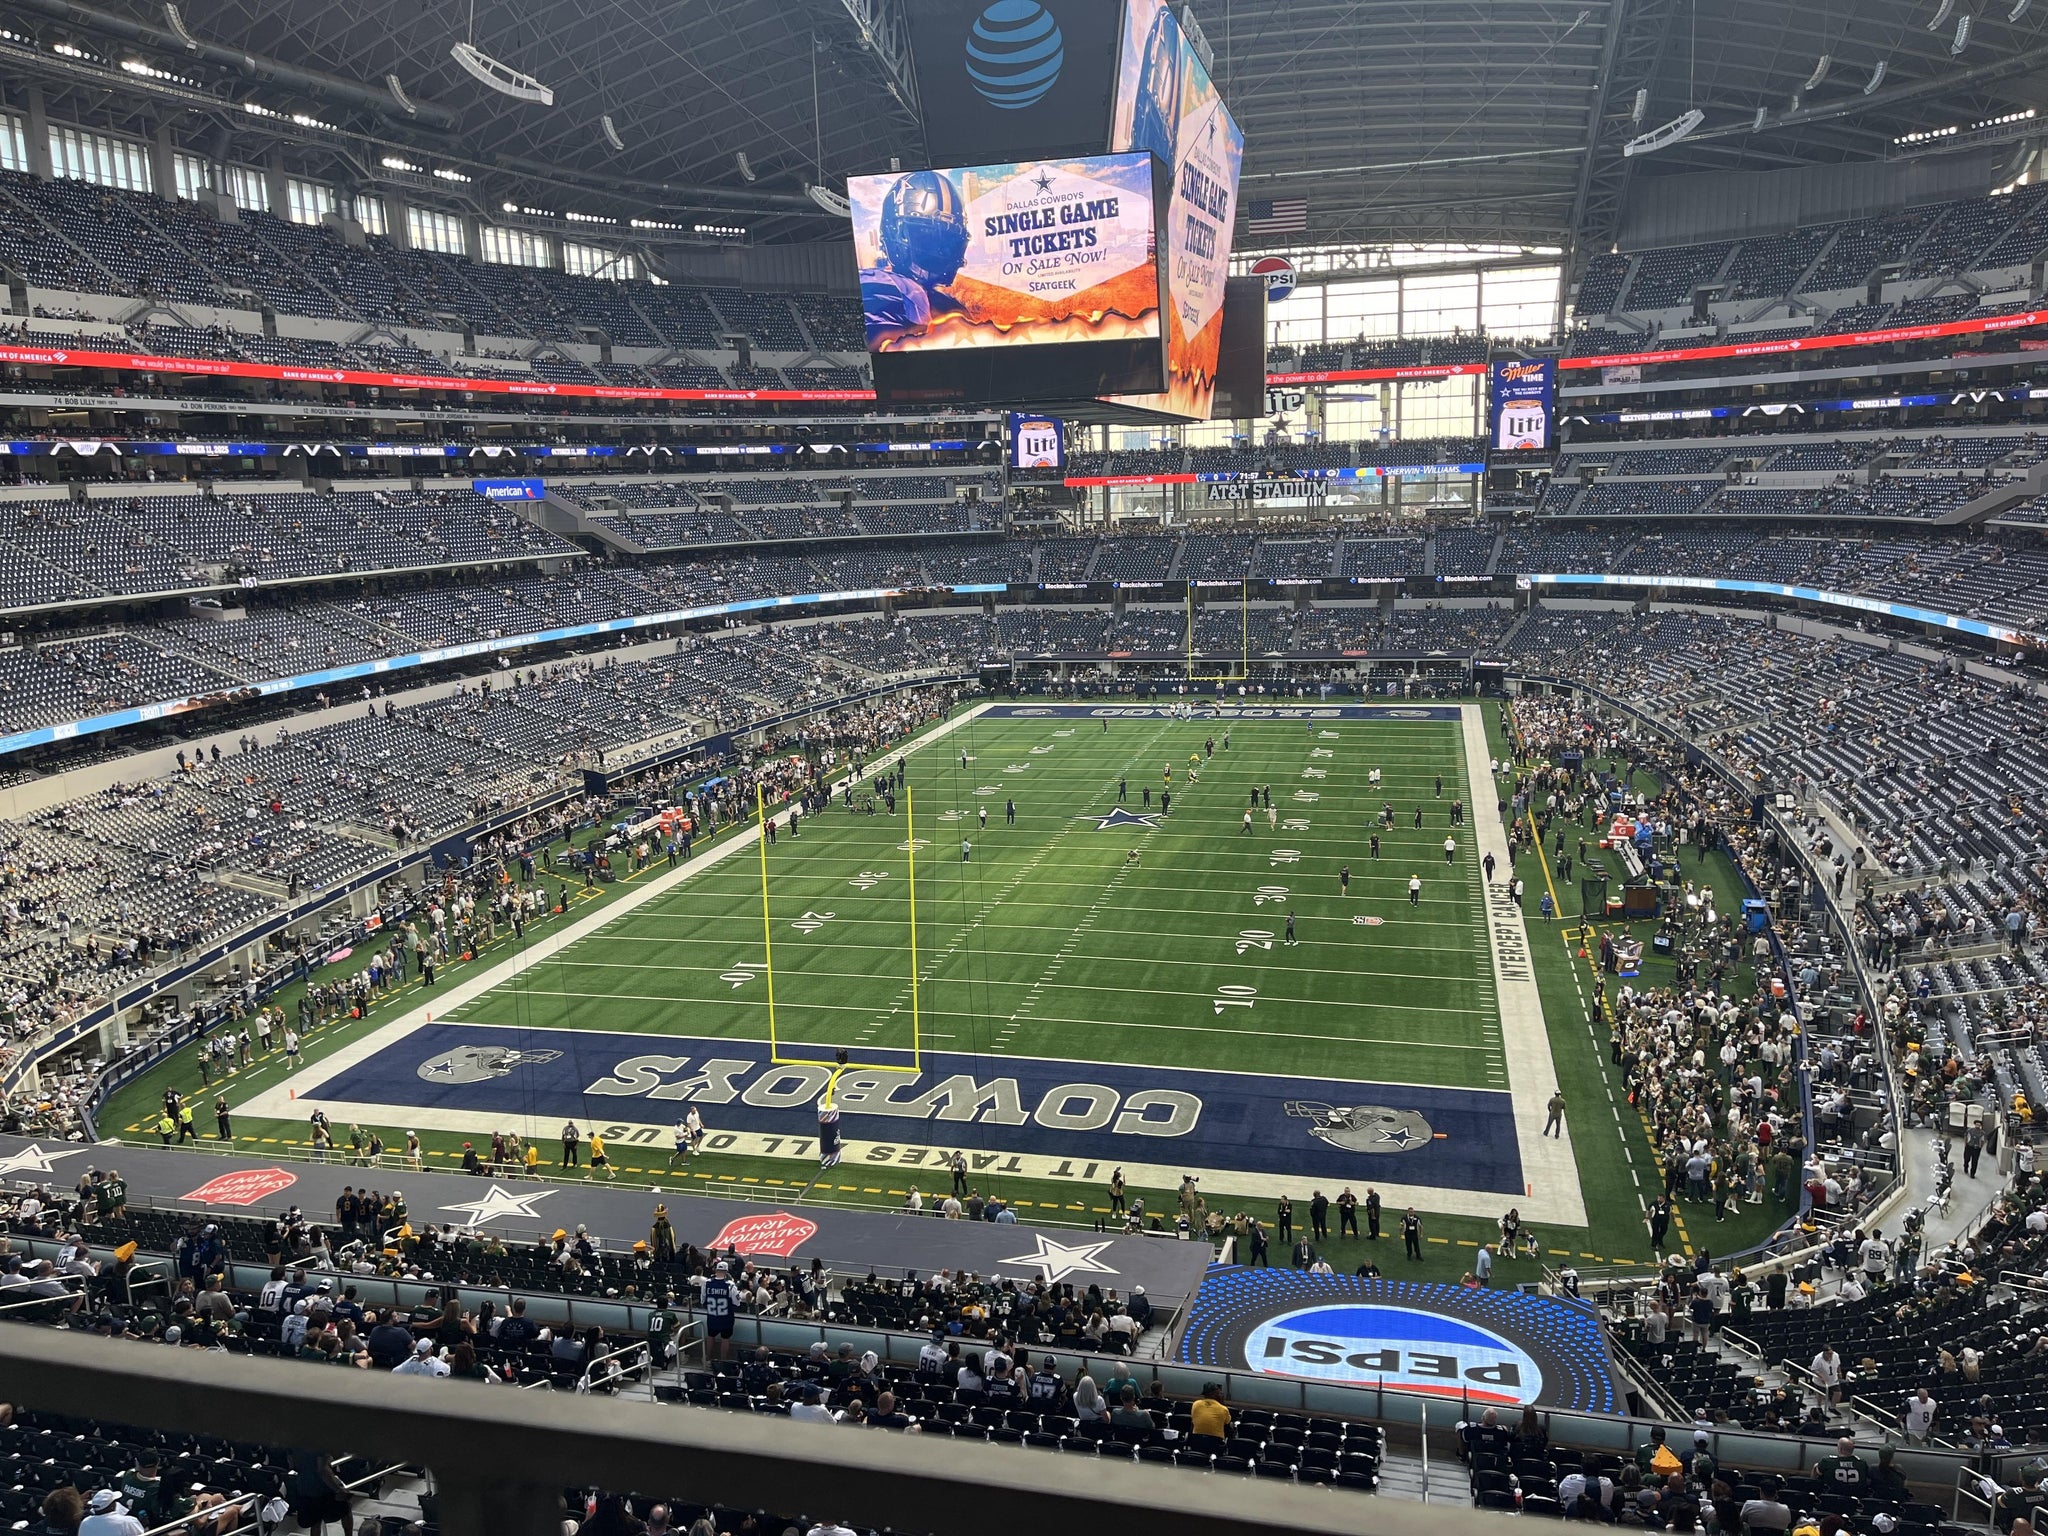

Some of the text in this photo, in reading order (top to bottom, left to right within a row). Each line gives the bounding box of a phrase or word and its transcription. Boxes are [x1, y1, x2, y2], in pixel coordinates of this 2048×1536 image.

[1181, 160, 1229, 222] SINGLE GAME
[1007, 191, 1084, 211] DALLAS COWBOYS
[985, 197, 1119, 237] SINGLE GAME
[1010, 226, 1098, 258] TICKETS
[1185, 214, 1217, 261] TICKETS
[1028, 278, 1077, 292] SEATGEEK
[2007, 318, 2027, 327] AMERICA
[1761, 344, 1788, 352] AMERICA
[9, 352, 53, 362] OF AMERICA
[131, 358, 230, 373] What would you like the power to do?
[1500, 363, 1545, 383] Miller
[1273, 374, 1284, 382] the
[1285, 374, 1306, 384] power
[1316, 373, 1328, 381] do?
[1522, 373, 1544, 382] TIME
[65, 397, 78, 405] BOB
[79, 398, 96, 406] LILLY
[1264, 389, 1304, 418] ite
[1508, 416, 1544, 438] Lite
[176, 445, 207, 454] OCTOBER
[214, 446, 229, 455] 2025
[1025, 437, 1056, 457] Lite
[485, 486, 523, 500] American
[1208, 481, 1328, 500] AT&T STADIUM
[1276, 578, 1322, 586] Blockchain.com
[1357, 576, 1405, 584] Blockchain.com
[1090, 708, 1342, 718] COWBOYS
[1268, 849, 1302, 863] 40
[849, 871, 889, 887] 30
[1254, 886, 1290, 903] 30
[791, 911, 836, 929] 20
[1488, 883, 1530, 982] INTERCEPT CANCER
[1235, 930, 1276, 951] 20
[720, 961, 768, 982] 10
[1213, 985, 1258, 1009] 10
[583, 1055, 1203, 1138] COWBOYS
[601, 1125, 1101, 1180] IT TAKES LL US
[199, 1177, 293, 1197] SALVATION
[221, 1174, 278, 1187] ARMY
[112, 1186, 123, 1197] 10
[213, 1190, 258, 1203] THE
[737, 1219, 790, 1234] ARMY
[719, 1225, 815, 1248] SALVATION
[745, 1238, 785, 1252] THE
[57, 1255, 68, 1267] 10
[1868, 1249, 1882, 1260] 89
[1566, 1276, 1575, 1290] 4
[260, 1291, 276, 1308] 10
[902, 1286, 914, 1298] 87
[283, 1296, 292, 1313] 4
[706, 1298, 729, 1316] 22
[649, 1317, 662, 1332] 10
[1630, 1328, 1636, 1341] 1
[920, 1358, 939, 1372] 88
[1262, 1335, 1522, 1388] PEPSI
[1828, 1365, 1833, 1376] 1
[1922, 1411, 1930, 1423] 8
[1834, 1468, 1860, 1484] 92
[124, 1484, 146, 1498] PARSONS
